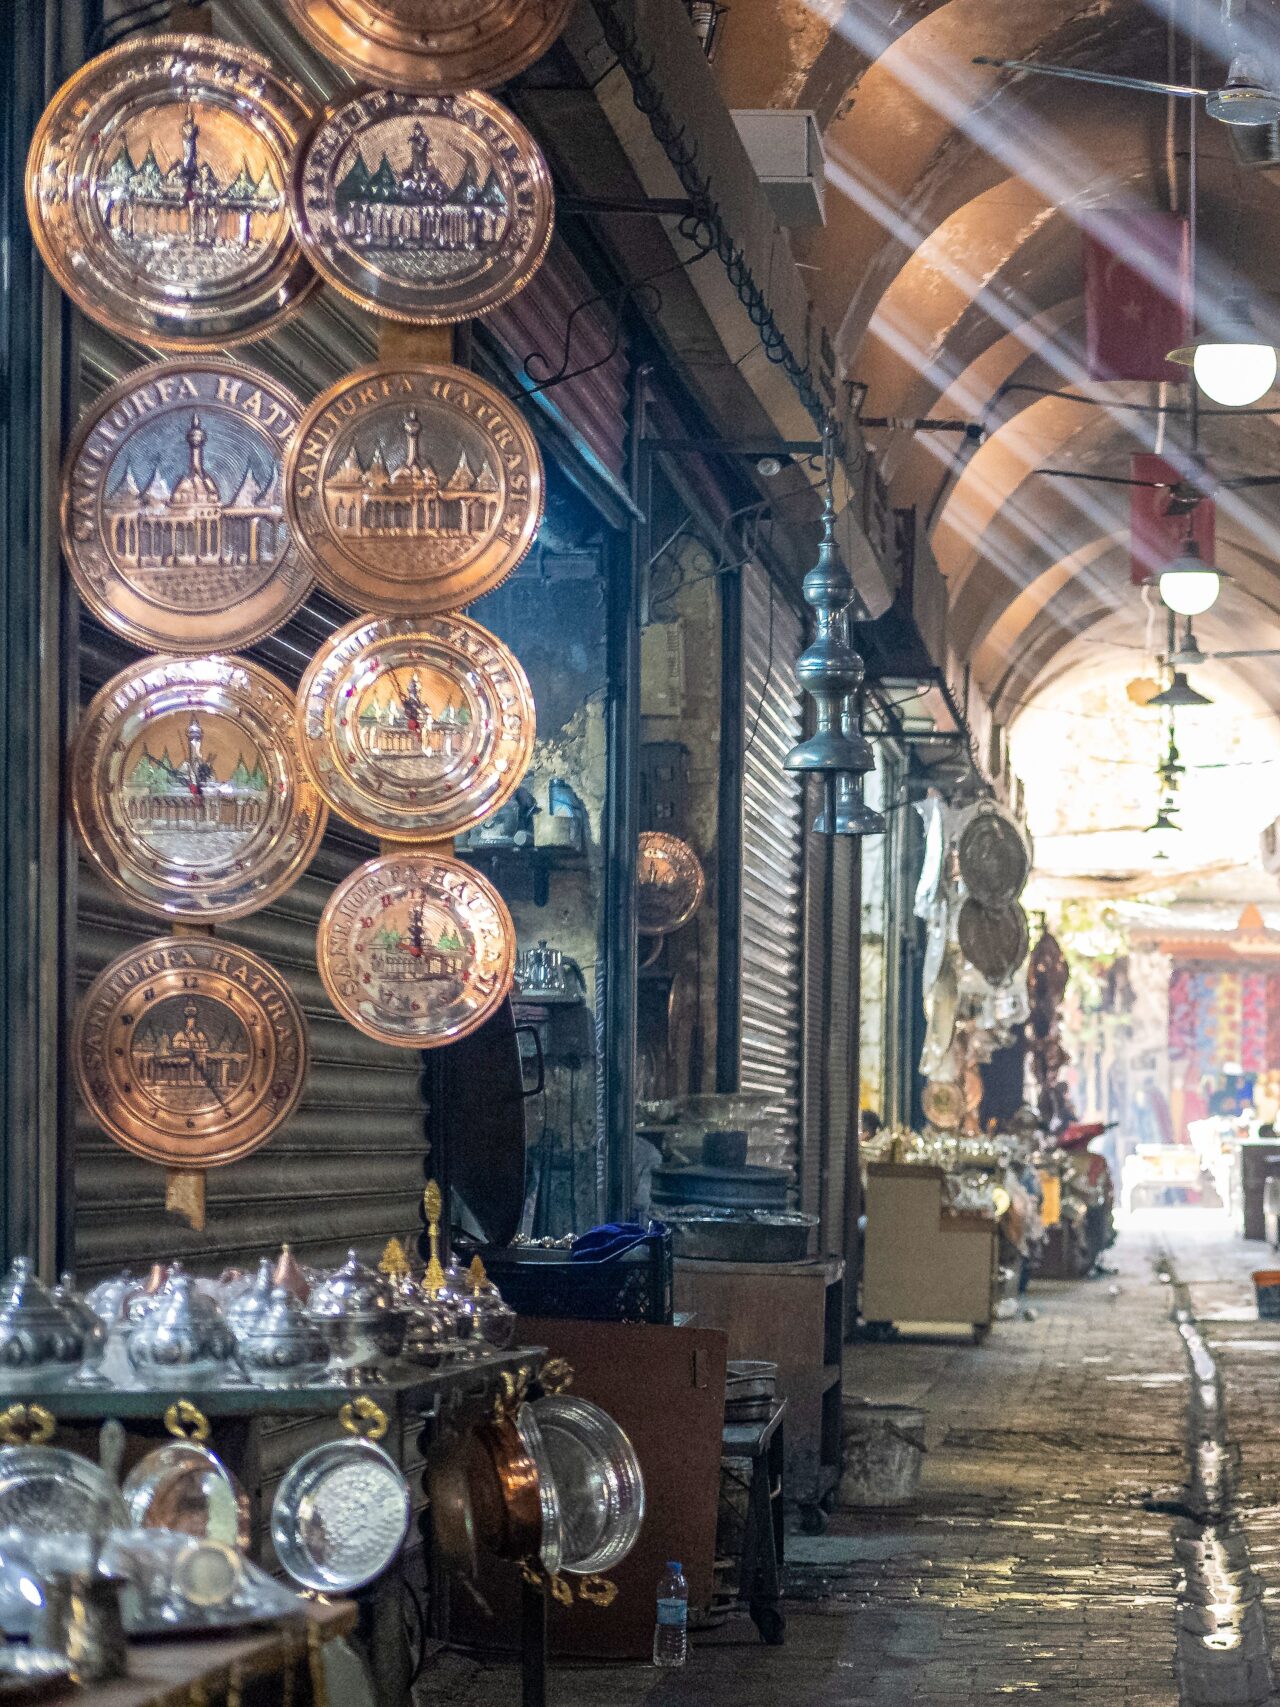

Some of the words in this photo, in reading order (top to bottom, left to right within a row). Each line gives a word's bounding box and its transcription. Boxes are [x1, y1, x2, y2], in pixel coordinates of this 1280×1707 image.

[298, 377, 414, 498] SANLIURFA
[431, 380, 529, 503] HATIRASI
[84, 949, 198, 1068] SANLIURFA
[208, 951, 297, 1074] HATIRASI
